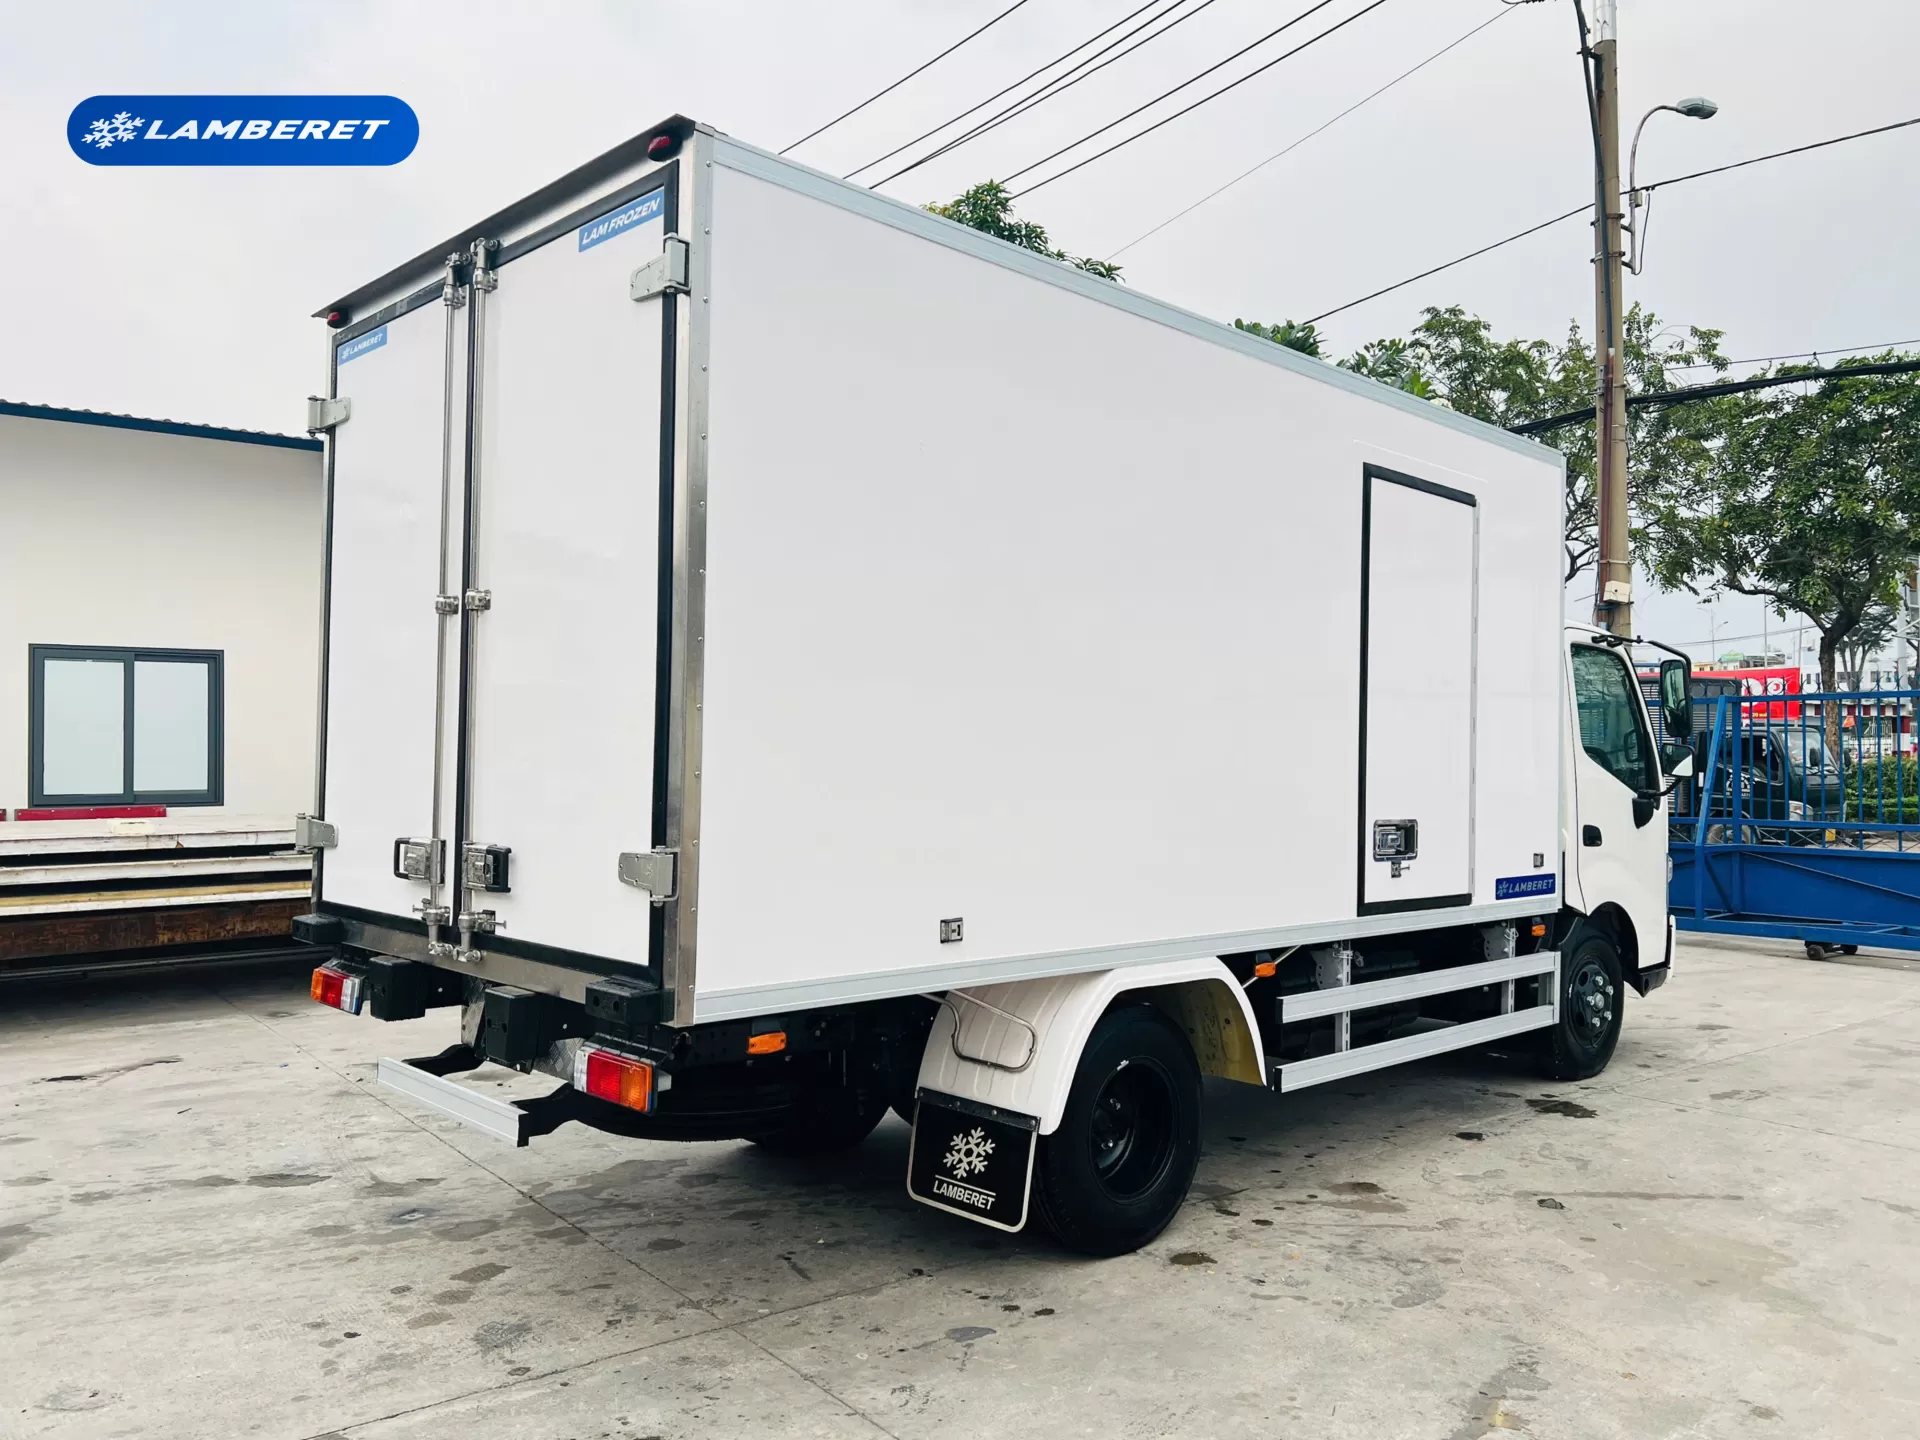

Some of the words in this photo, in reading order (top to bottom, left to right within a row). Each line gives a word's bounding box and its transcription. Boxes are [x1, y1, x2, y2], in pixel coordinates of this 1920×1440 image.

[582, 222, 609, 245] LAM
[608, 198, 660, 232] FROZEN
[350, 333, 383, 355] LAMBERET
[1508, 879, 1553, 893] LAMBERET
[933, 1180, 995, 1210] LAMBERET
